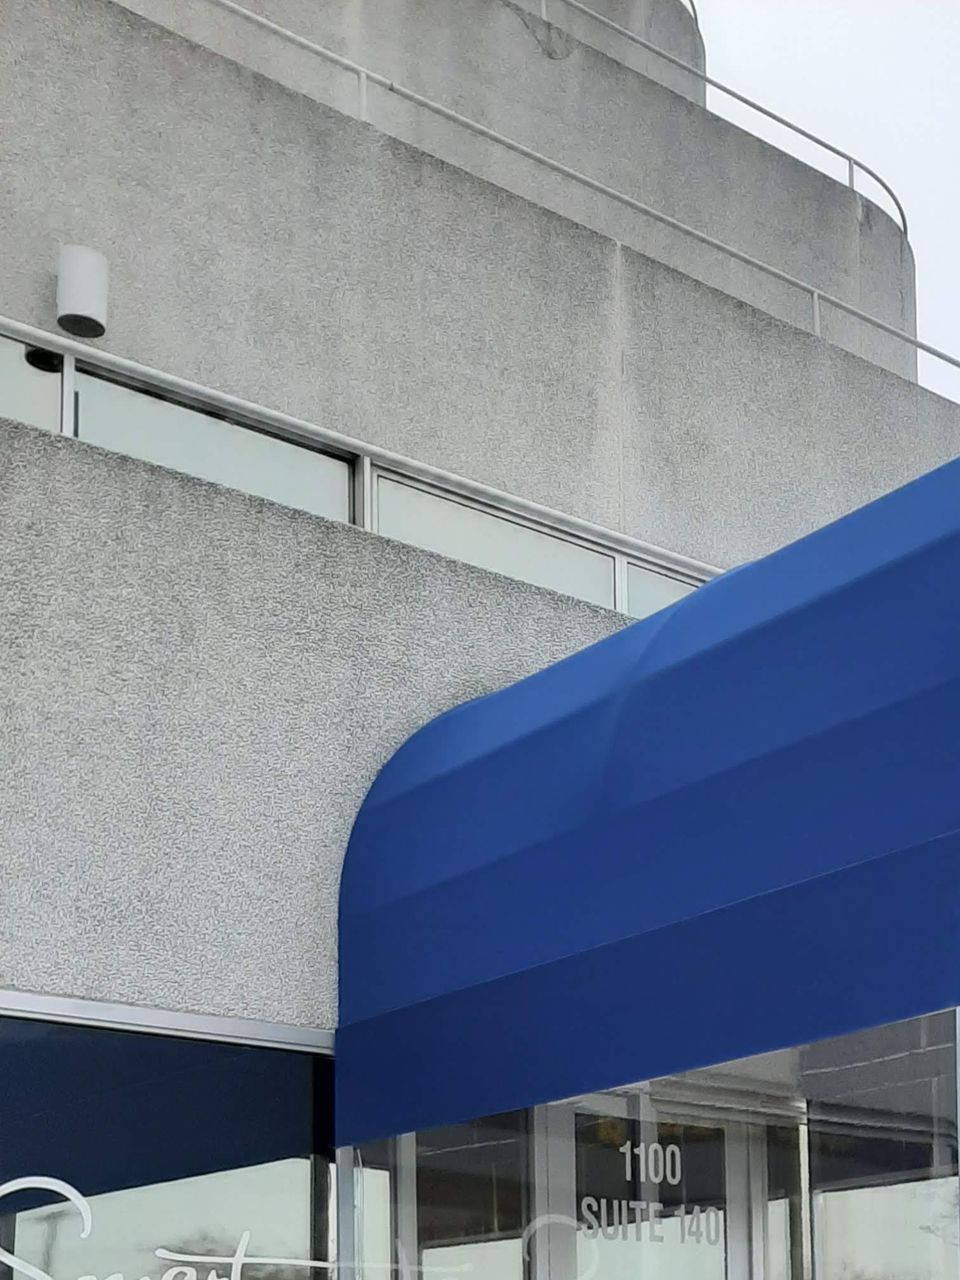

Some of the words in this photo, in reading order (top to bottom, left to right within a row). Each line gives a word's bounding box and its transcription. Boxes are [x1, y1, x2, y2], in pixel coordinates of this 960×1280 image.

[619, 1140, 682, 1185] 1100
[581, 1197, 665, 1244] SUITE
[674, 1204, 721, 1246] 140
